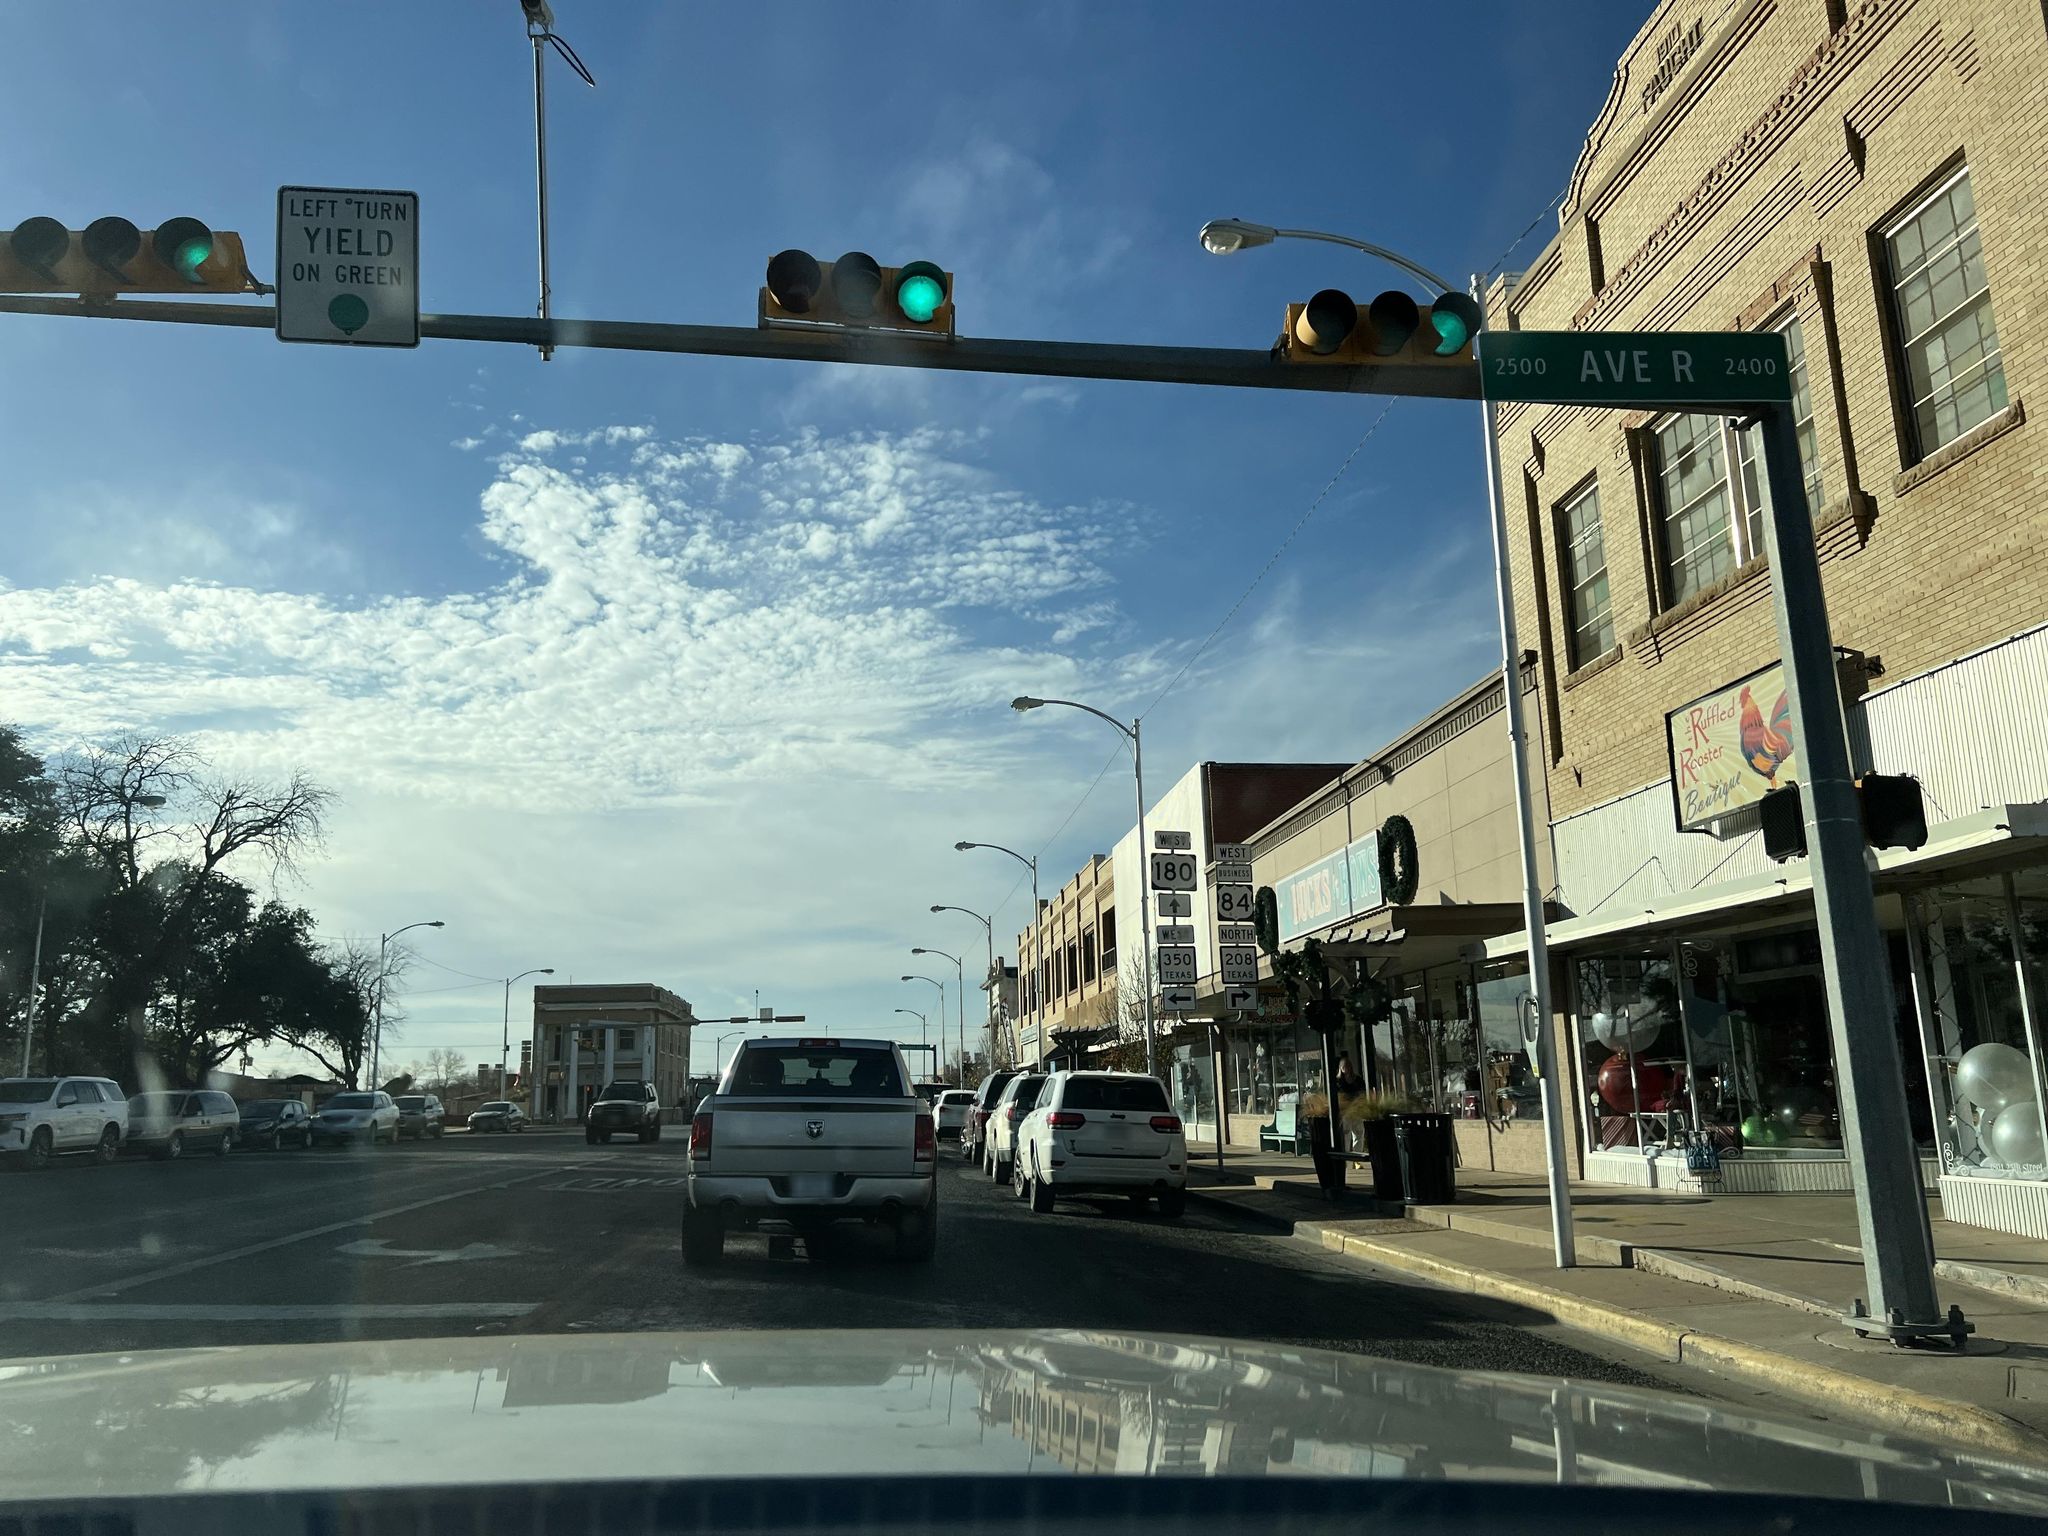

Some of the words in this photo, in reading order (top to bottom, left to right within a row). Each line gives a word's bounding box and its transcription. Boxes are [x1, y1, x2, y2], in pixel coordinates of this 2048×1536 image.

[289, 198, 338, 218] LEFT
[354, 200, 407, 221] TURN
[303, 226, 394, 257] YIELD
[292, 262, 320, 282] ON
[335, 264, 402, 286] GREEN
[1495, 358, 1547, 376] 2500
[1580, 350, 1651, 383] AVE
[1671, 350, 1695, 383] R
[1724, 358, 1777, 376] 2400
[1690, 696, 1736, 750] Ruffled
[1679, 745, 1724, 790] Rooster
[1219, 847, 1247, 858] WEST
[1155, 861, 1193, 881] 180
[1218, 869, 1250, 878] BUSINESS
[1221, 892, 1250, 912] 84
[1220, 929, 1254, 940] NORTH
[1163, 953, 1192, 966] 350
[1225, 953, 1253, 966] 208
[1165, 971, 1192, 979] TEXAS
[1226, 971, 1254, 979] TEXAS
[1688, 1155, 1717, 1169] OPEN
